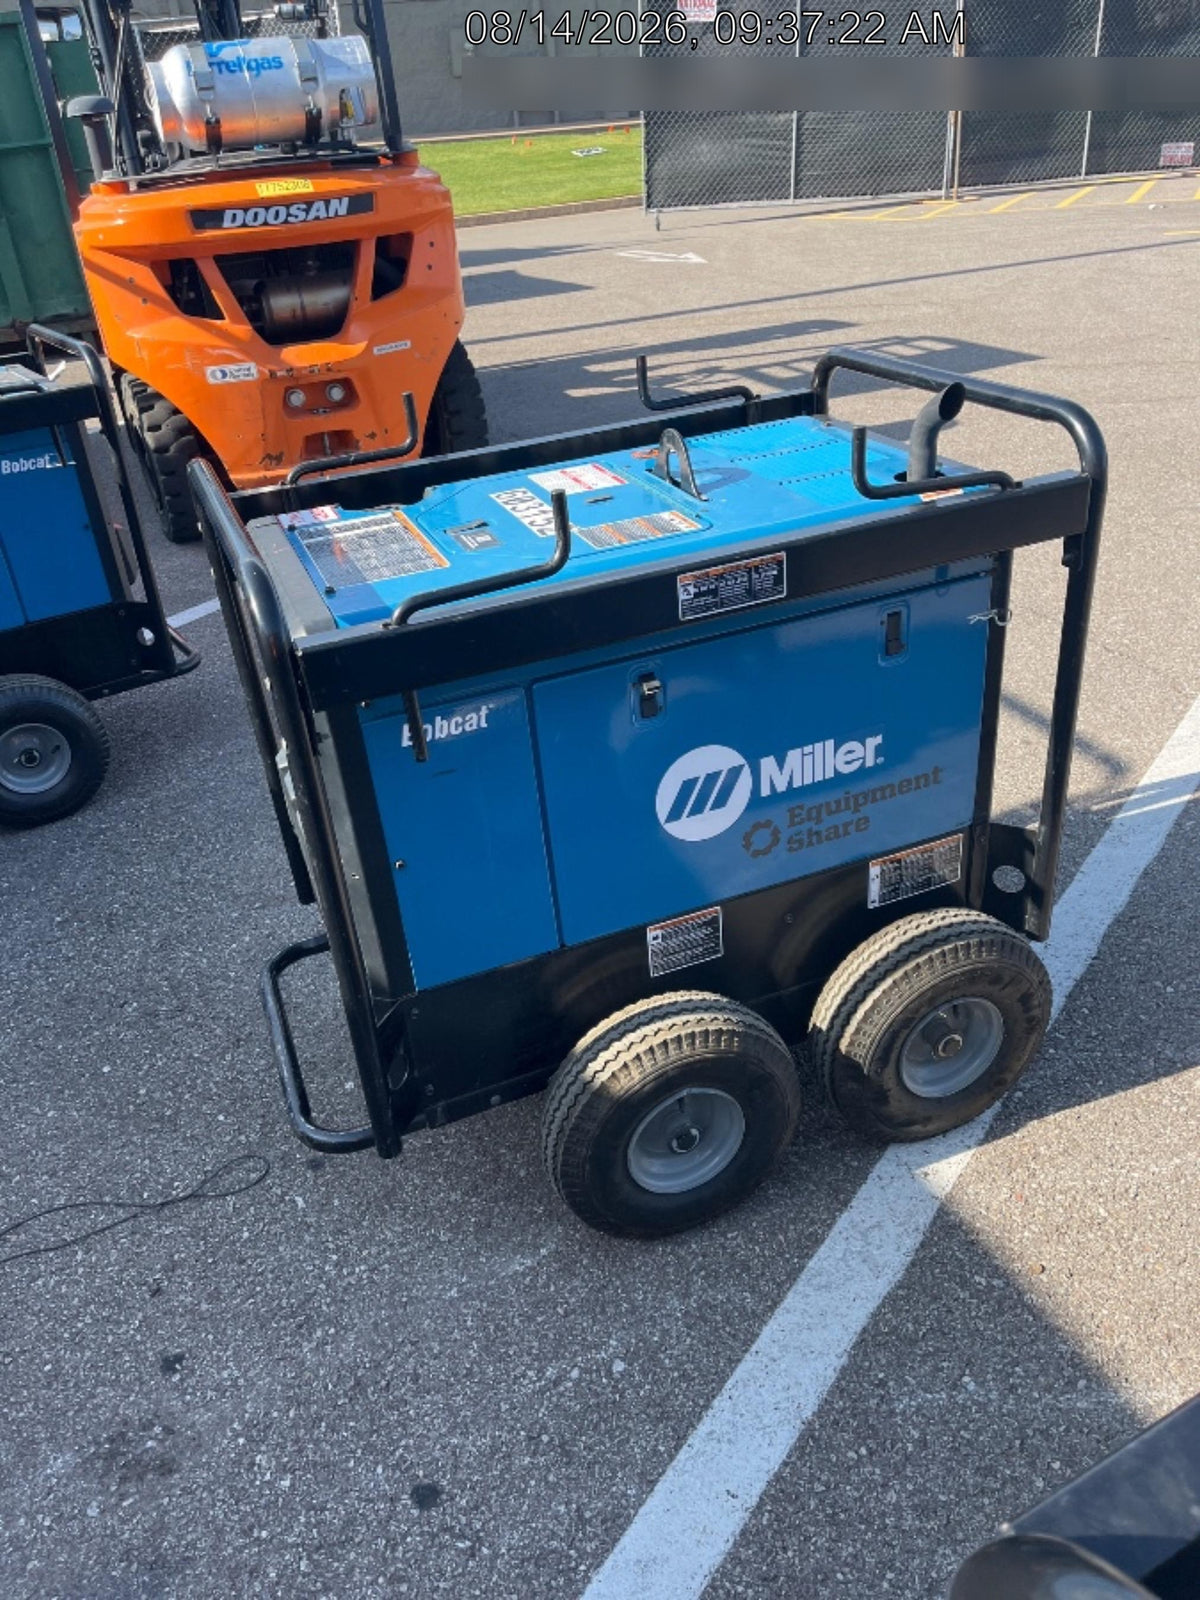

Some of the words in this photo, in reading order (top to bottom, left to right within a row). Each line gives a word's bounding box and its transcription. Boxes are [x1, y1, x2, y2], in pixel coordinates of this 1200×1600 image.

[222, 197, 350, 229] DOOSAN
[1, 453, 51, 475] Bobcat
[760, 734, 884, 798] Miller
[787, 766, 943, 829] Equipment
[787, 815, 871, 853] Share
